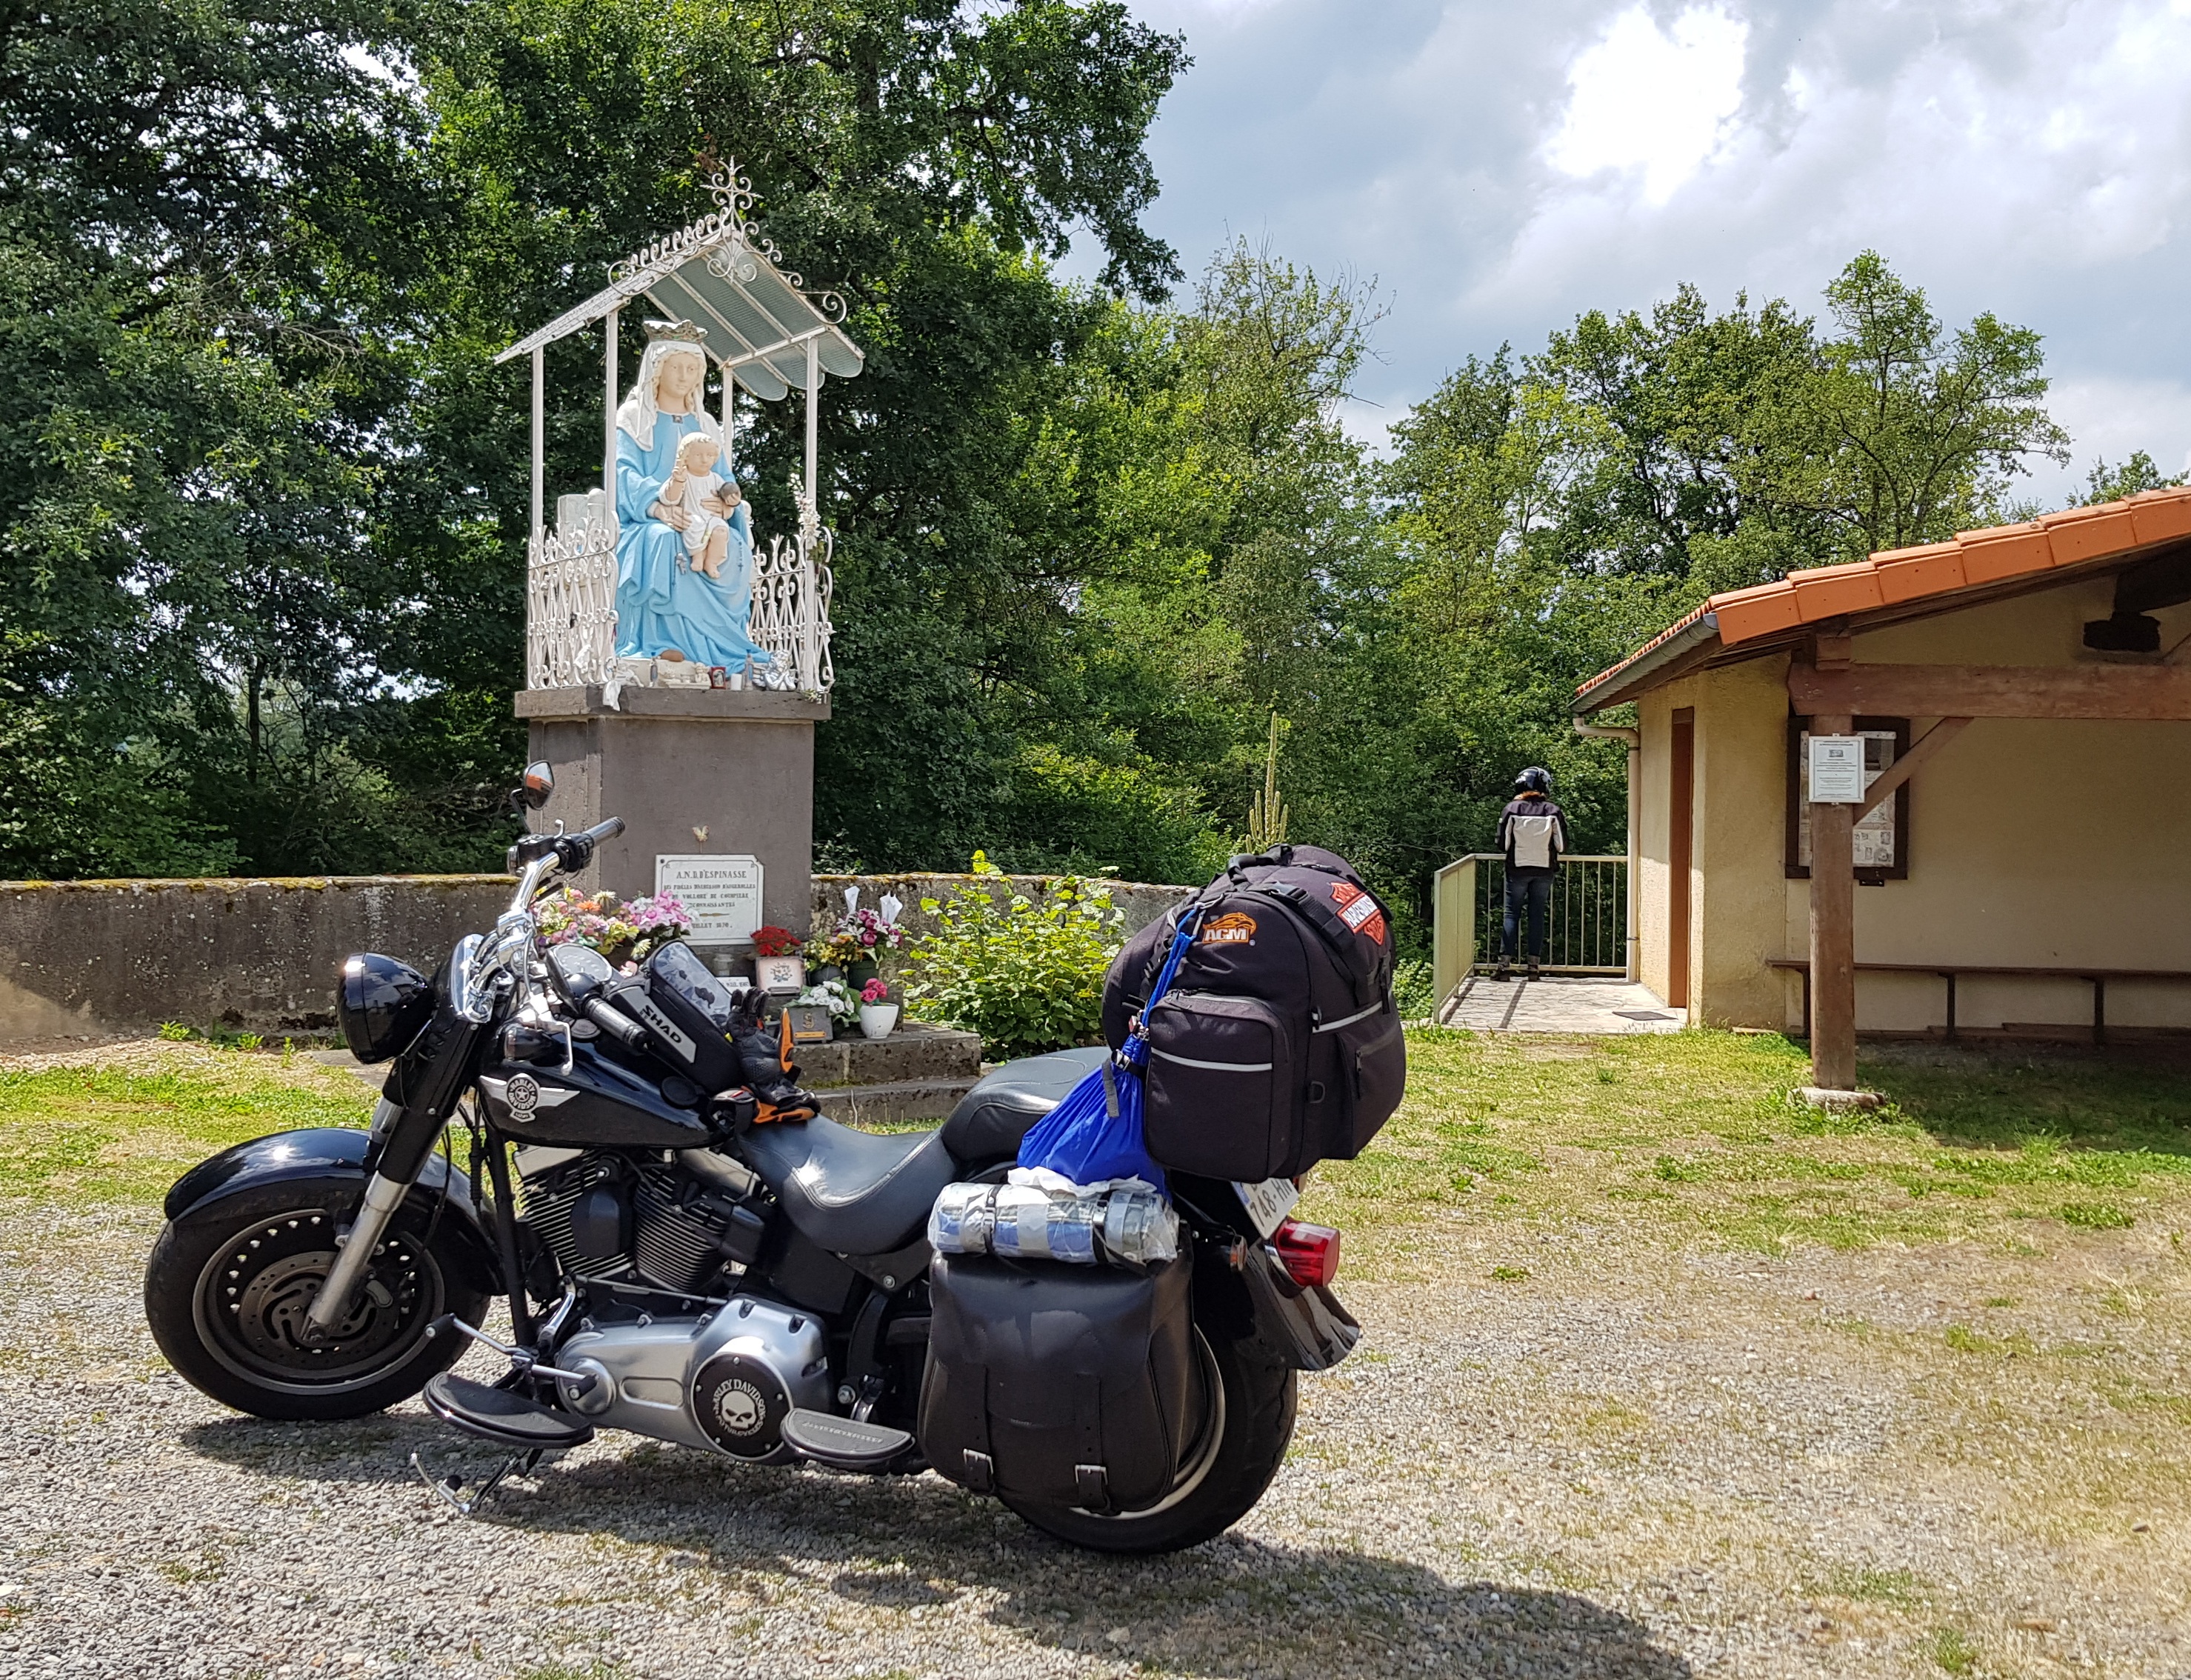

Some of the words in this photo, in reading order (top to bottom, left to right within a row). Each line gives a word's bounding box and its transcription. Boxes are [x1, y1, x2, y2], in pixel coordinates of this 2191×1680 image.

[643, 1005, 681, 1043] SHAD
[510, 1079, 536, 1092] HARLEY
[508, 1092, 536, 1110] DAVIDSON
[733, 1379, 767, 1417] DAVIDSON
